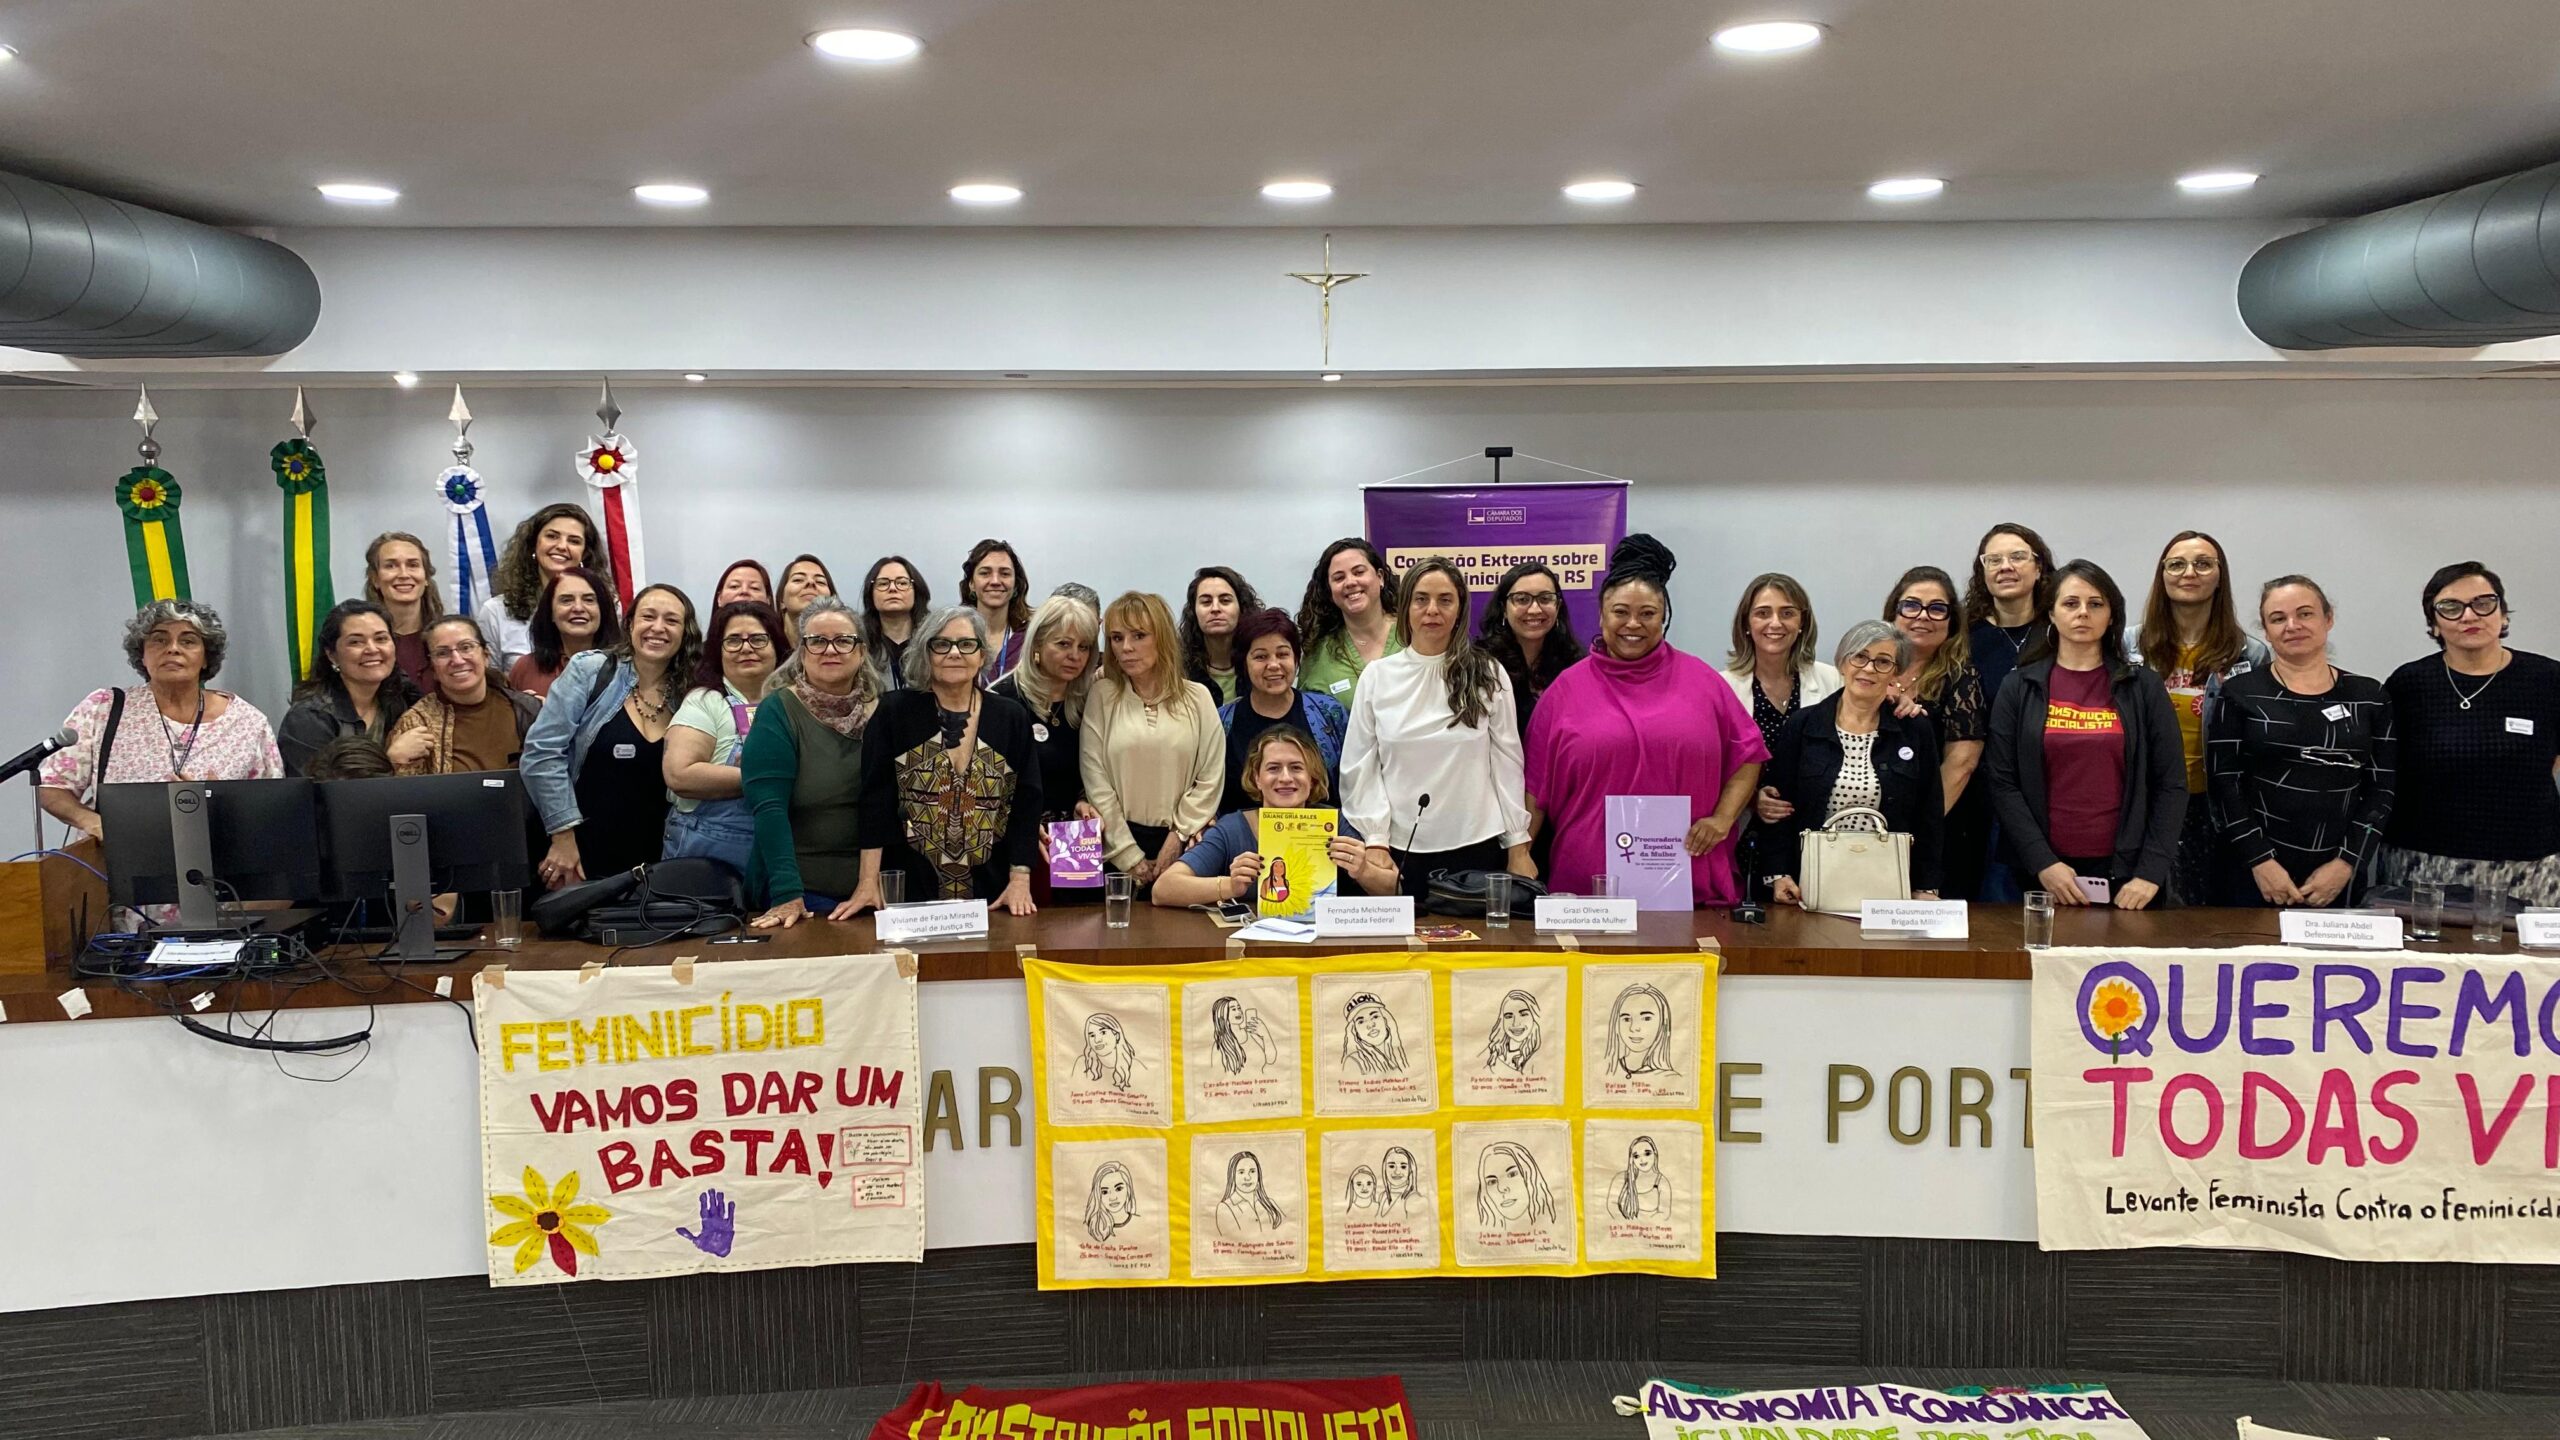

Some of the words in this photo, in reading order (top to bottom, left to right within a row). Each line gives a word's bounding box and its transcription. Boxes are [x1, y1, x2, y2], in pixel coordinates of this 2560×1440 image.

[1552, 552, 1599, 566] sobre
[1564, 569, 1586, 584] RS
[2048, 704, 2118, 722] ONSTRUÇÃO
[1070, 845, 1096, 853] TODAS
[1361, 906, 1401, 914] Melchionna
[1563, 906, 1581, 914] Grazi
[1582, 906, 1609, 914] Oliveira
[1895, 908, 1934, 916] Gausmann
[890, 916, 919, 925] Viviane
[919, 915, 929, 923] de
[930, 913, 948, 921] Faria
[949, 911, 979, 920] Miranda
[1334, 917, 1369, 925] Deputada
[1370, 916, 1395, 924] Federal
[1546, 917, 1590, 925] Procuradoria
[1602, 916, 1628, 925] Mulher
[1891, 918, 1919, 927] Brigada
[2323, 920, 2349, 929] Juliana
[928, 924, 938, 932] de
[940, 923, 963, 932] Justiça
[964, 921, 974, 929] RS
[2304, 930, 2345, 939] Defensoria
[2347, 932, 2374, 940] Pública
[2076, 961, 2560, 1061] QUEREM
[500, 990, 825, 1072] FEMINICÍDIO
[530, 1079, 698, 1134] VAMOS
[721, 1070, 824, 1117] DAR
[836, 1065, 905, 1110] UM
[1828, 1063, 2035, 1149] PORT
[2082, 1066, 2421, 1169] TODAS
[597, 1128, 835, 1195] BASTA!
[2105, 1186, 2198, 1215] Levante
[2208, 1178, 2325, 1219] Feminista
[2336, 1187, 2413, 1222] Contra
[2420, 1204, 2437, 1219] o
[1649, 1383, 1880, 1423] AUTONOMIA
[1878, 1385, 2131, 1424] ECONÔMICA
